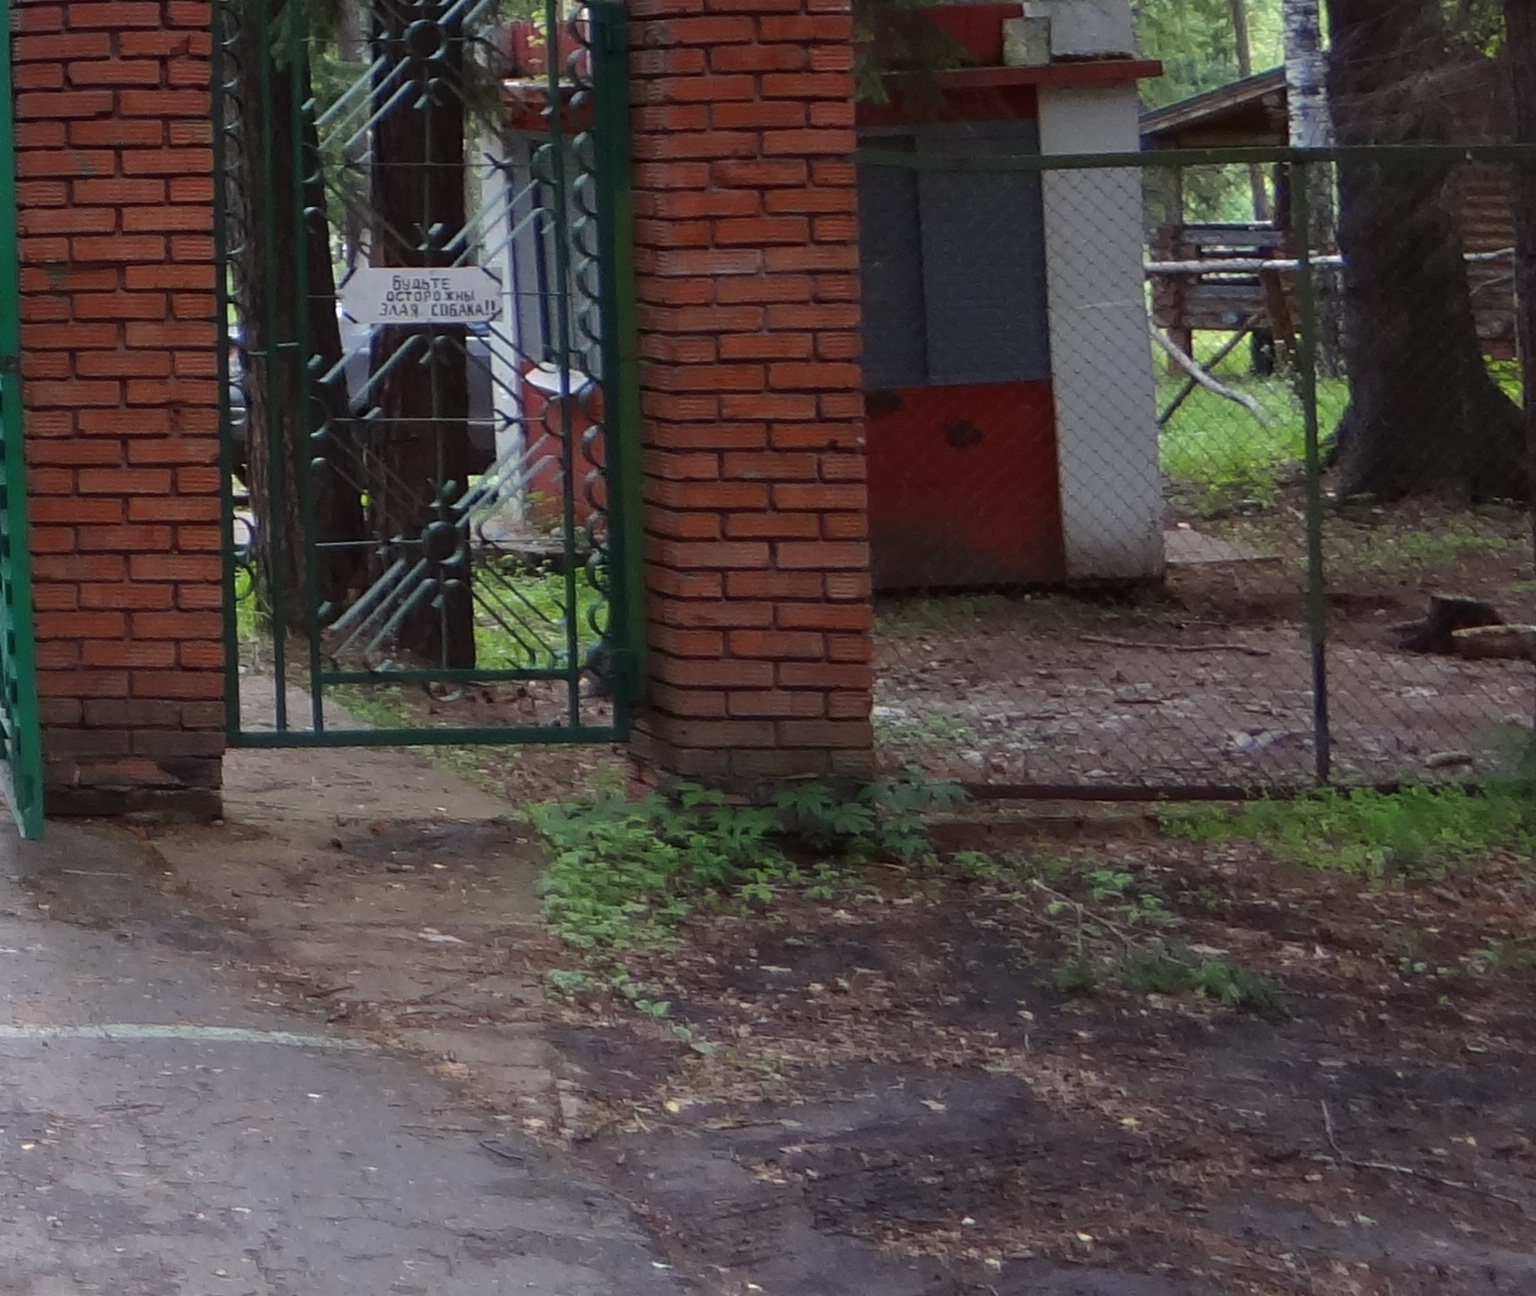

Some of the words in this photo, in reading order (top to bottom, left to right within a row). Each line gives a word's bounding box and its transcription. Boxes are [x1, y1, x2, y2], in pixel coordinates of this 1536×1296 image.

[392, 275, 451, 291] БУДЬТЕ
[385, 290, 475, 303] ОСТОРОЖНЫ
[379, 303, 420, 318] ЗЛАЯ
